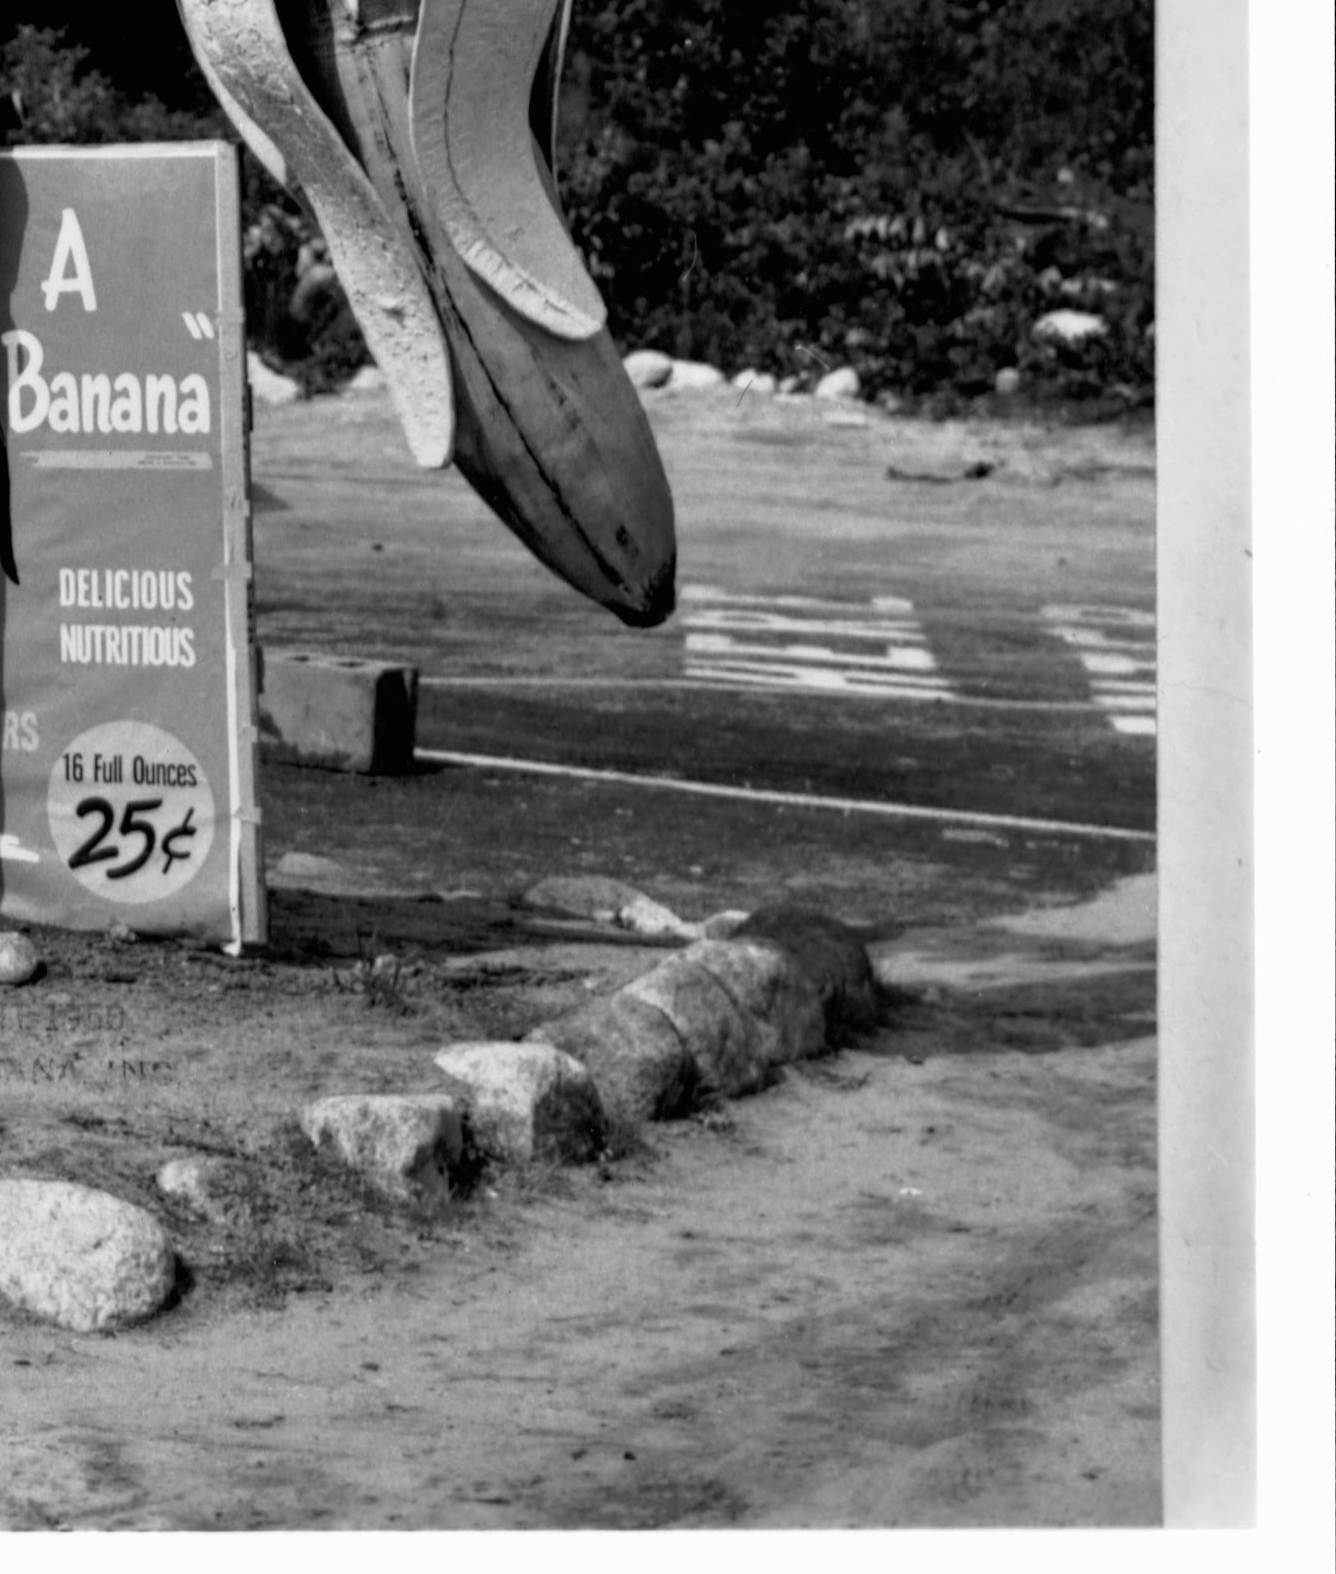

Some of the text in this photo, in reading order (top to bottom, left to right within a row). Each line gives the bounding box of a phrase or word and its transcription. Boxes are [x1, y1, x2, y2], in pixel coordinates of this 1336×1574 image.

[40, 208, 97, 312] A
[58, 567, 194, 612] DELICIOUS
[59, 624, 197, 668] NUTRITIOUS
[62, 752, 198, 787] 16 Full Ounces
[67, 796, 197, 880] 25¢
